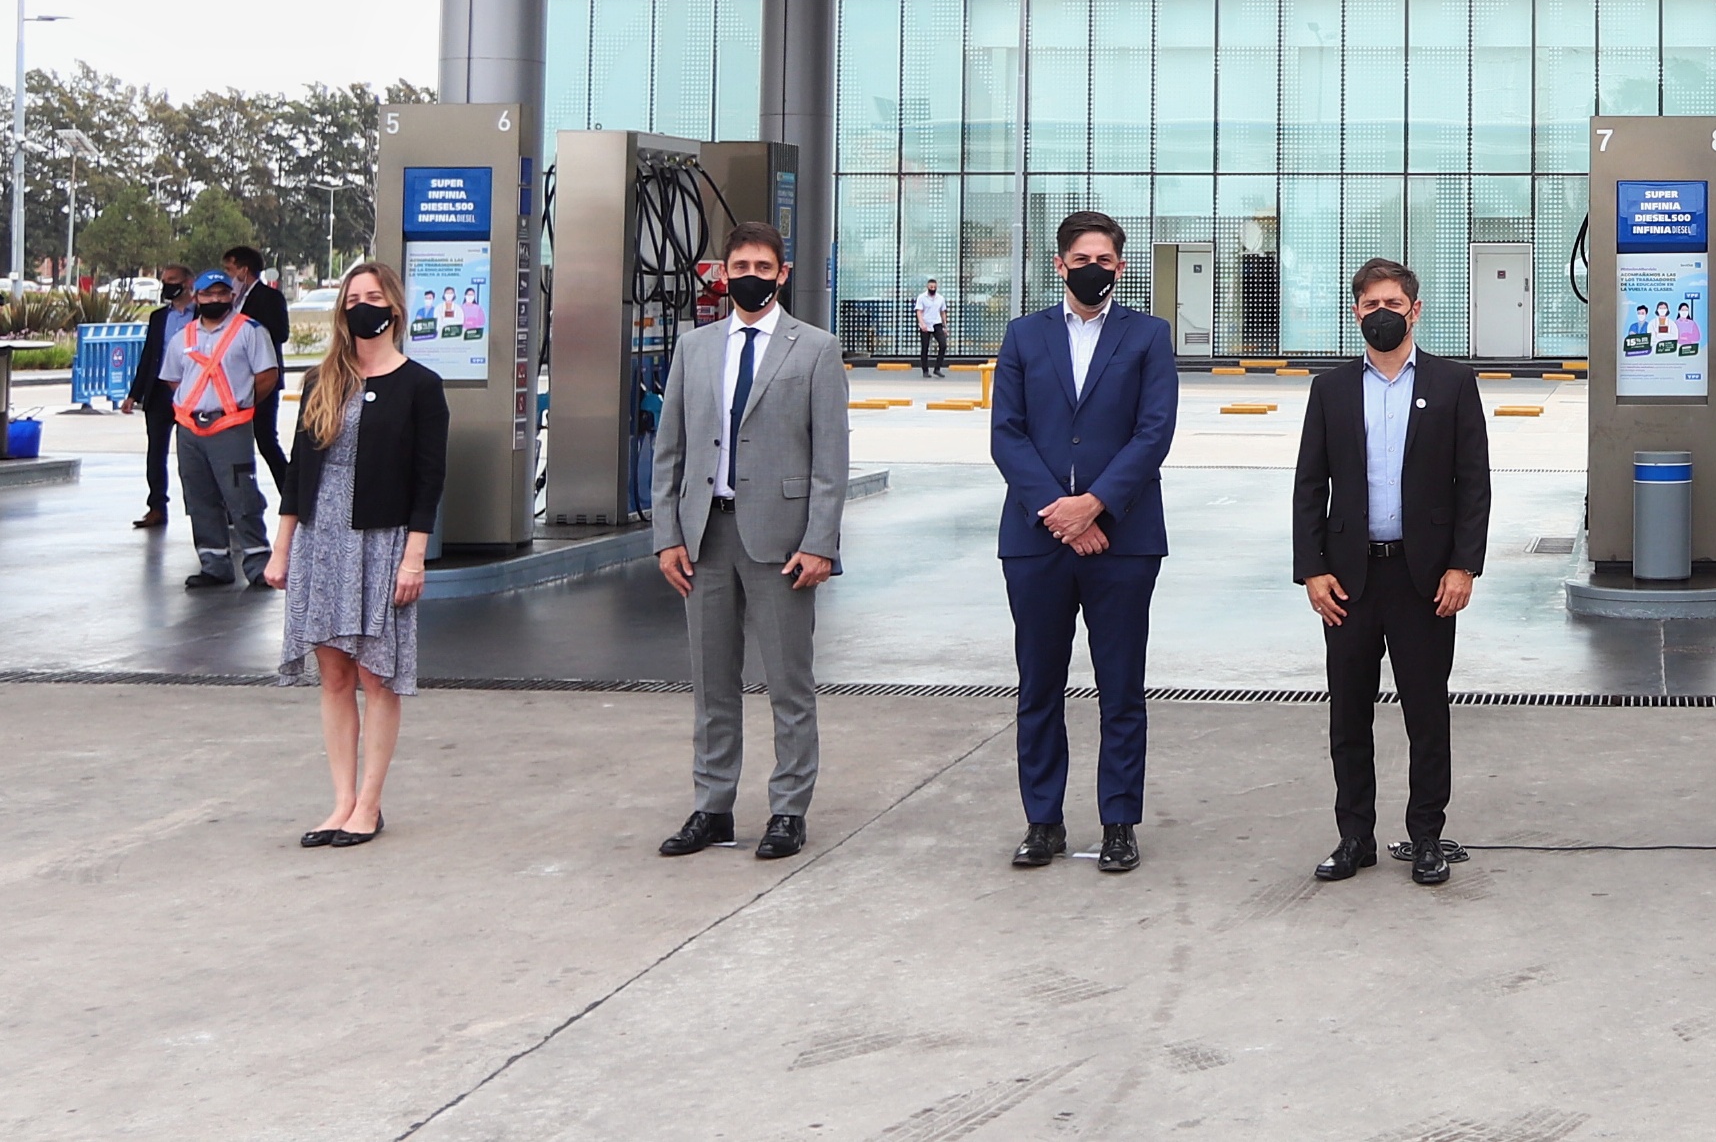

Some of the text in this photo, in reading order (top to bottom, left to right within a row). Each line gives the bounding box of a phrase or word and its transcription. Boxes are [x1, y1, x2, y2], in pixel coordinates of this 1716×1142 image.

[386, 113, 399, 134] 5
[498, 110, 511, 131] 6
[1596, 129, 1613, 152] 7
[430, 179, 463, 188] SUPER
[428, 191, 467, 199] INFINIA
[1644, 190, 1678, 198] SUPER
[1640, 202, 1681, 210] INFINIA
